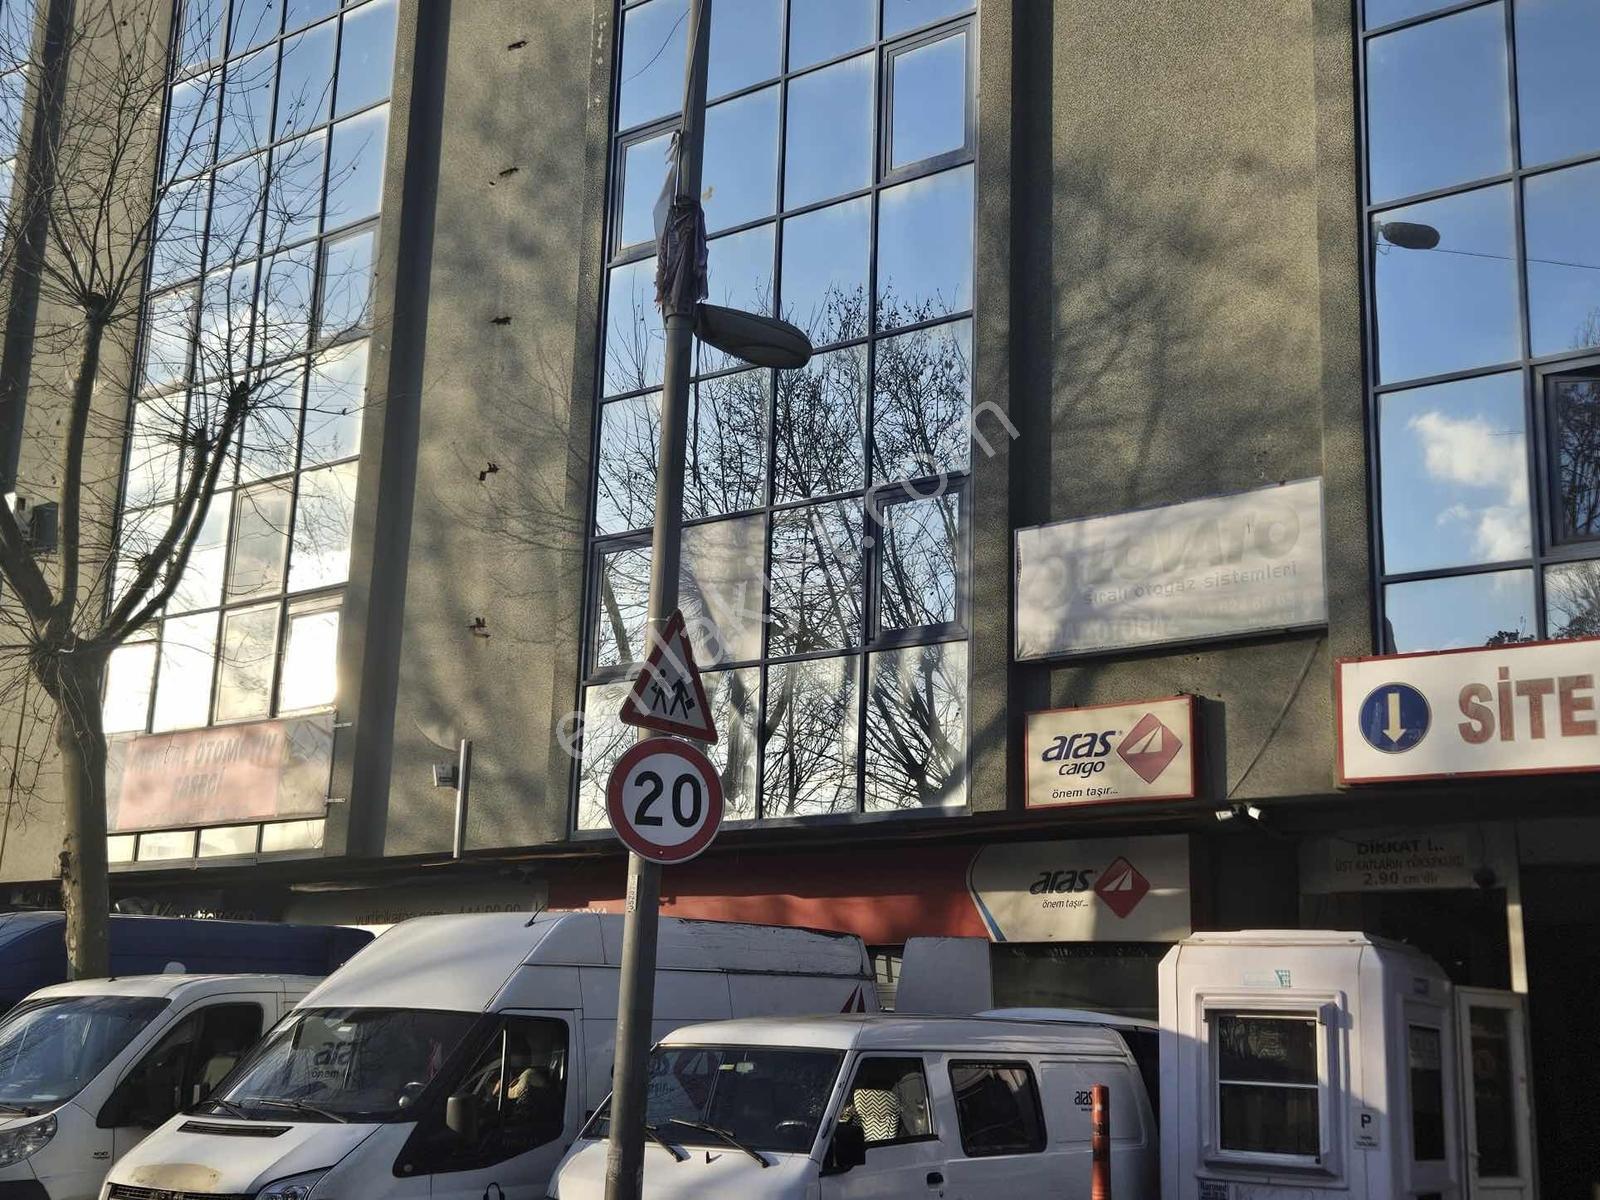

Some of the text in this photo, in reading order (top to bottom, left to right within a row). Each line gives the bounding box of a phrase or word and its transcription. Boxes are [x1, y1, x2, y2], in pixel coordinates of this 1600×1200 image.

[1134, 579, 1195, 601] otogaz
[1203, 562, 1297, 588] sistemleri
[1458, 666, 1597, 745] SİTE
[1041, 730, 1116, 762] aras
[1059, 761, 1105, 778] cargo
[634, 771, 702, 828] 20
[1052, 788, 1083, 799] önem
[1029, 869, 1094, 895] aras
[1363, 871, 1399, 886] 2.90
[1042, 900, 1065, 909] önem
[1360, 1113, 1372, 1129] P
